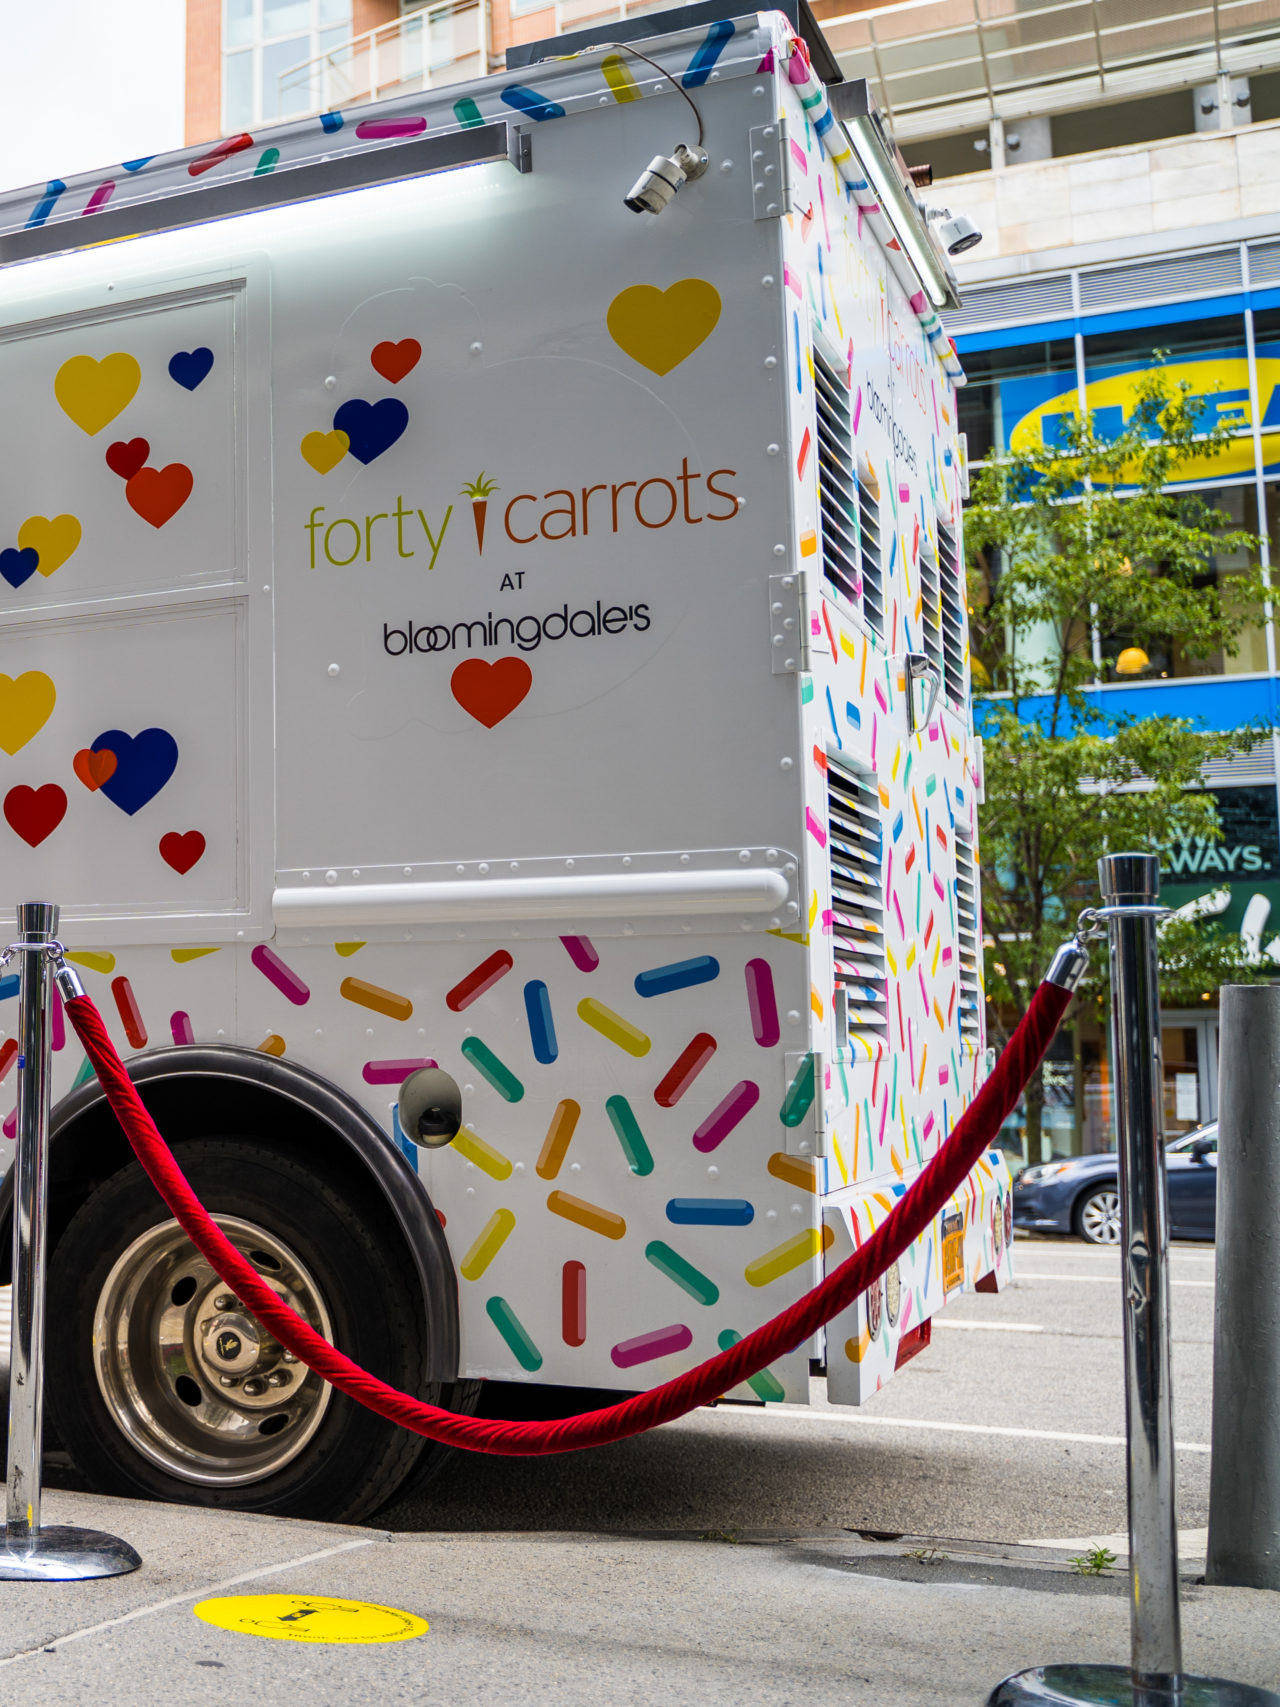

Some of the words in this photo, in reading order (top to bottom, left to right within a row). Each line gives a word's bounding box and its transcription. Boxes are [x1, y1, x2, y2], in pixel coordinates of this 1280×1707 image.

[304, 495, 453, 570] forty
[504, 456, 740, 544] carrots
[499, 571, 526, 592] AT
[384, 600, 651, 656] bloomingdale's
